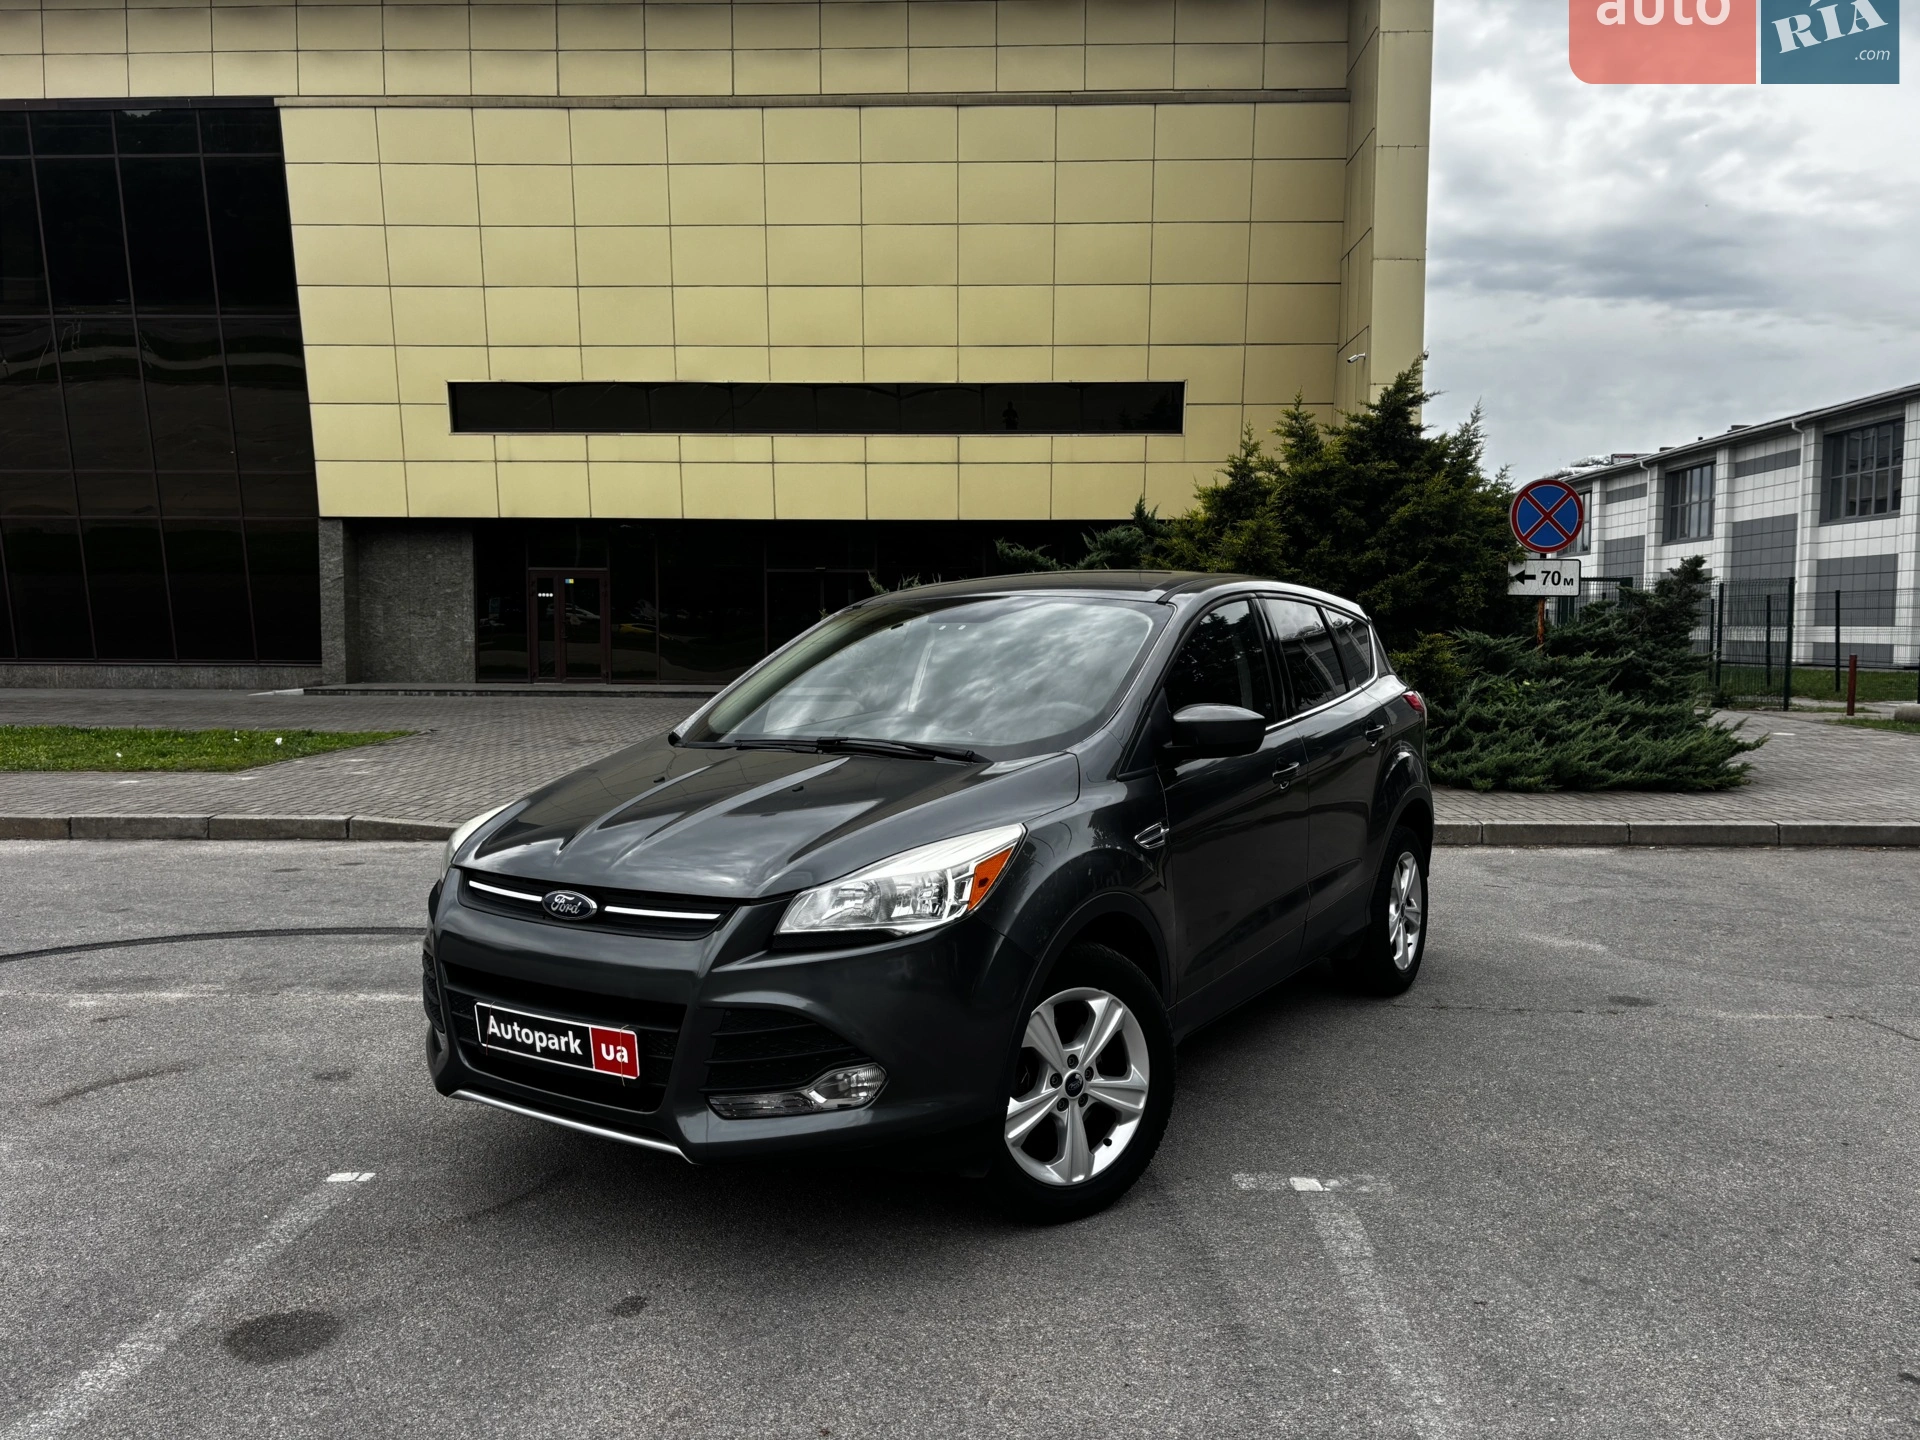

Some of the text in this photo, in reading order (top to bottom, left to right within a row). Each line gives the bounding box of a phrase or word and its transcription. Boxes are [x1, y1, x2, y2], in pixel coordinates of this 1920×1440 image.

[550, 894, 582, 914] Ford
[488, 1015, 629, 1064] Autopark ua
